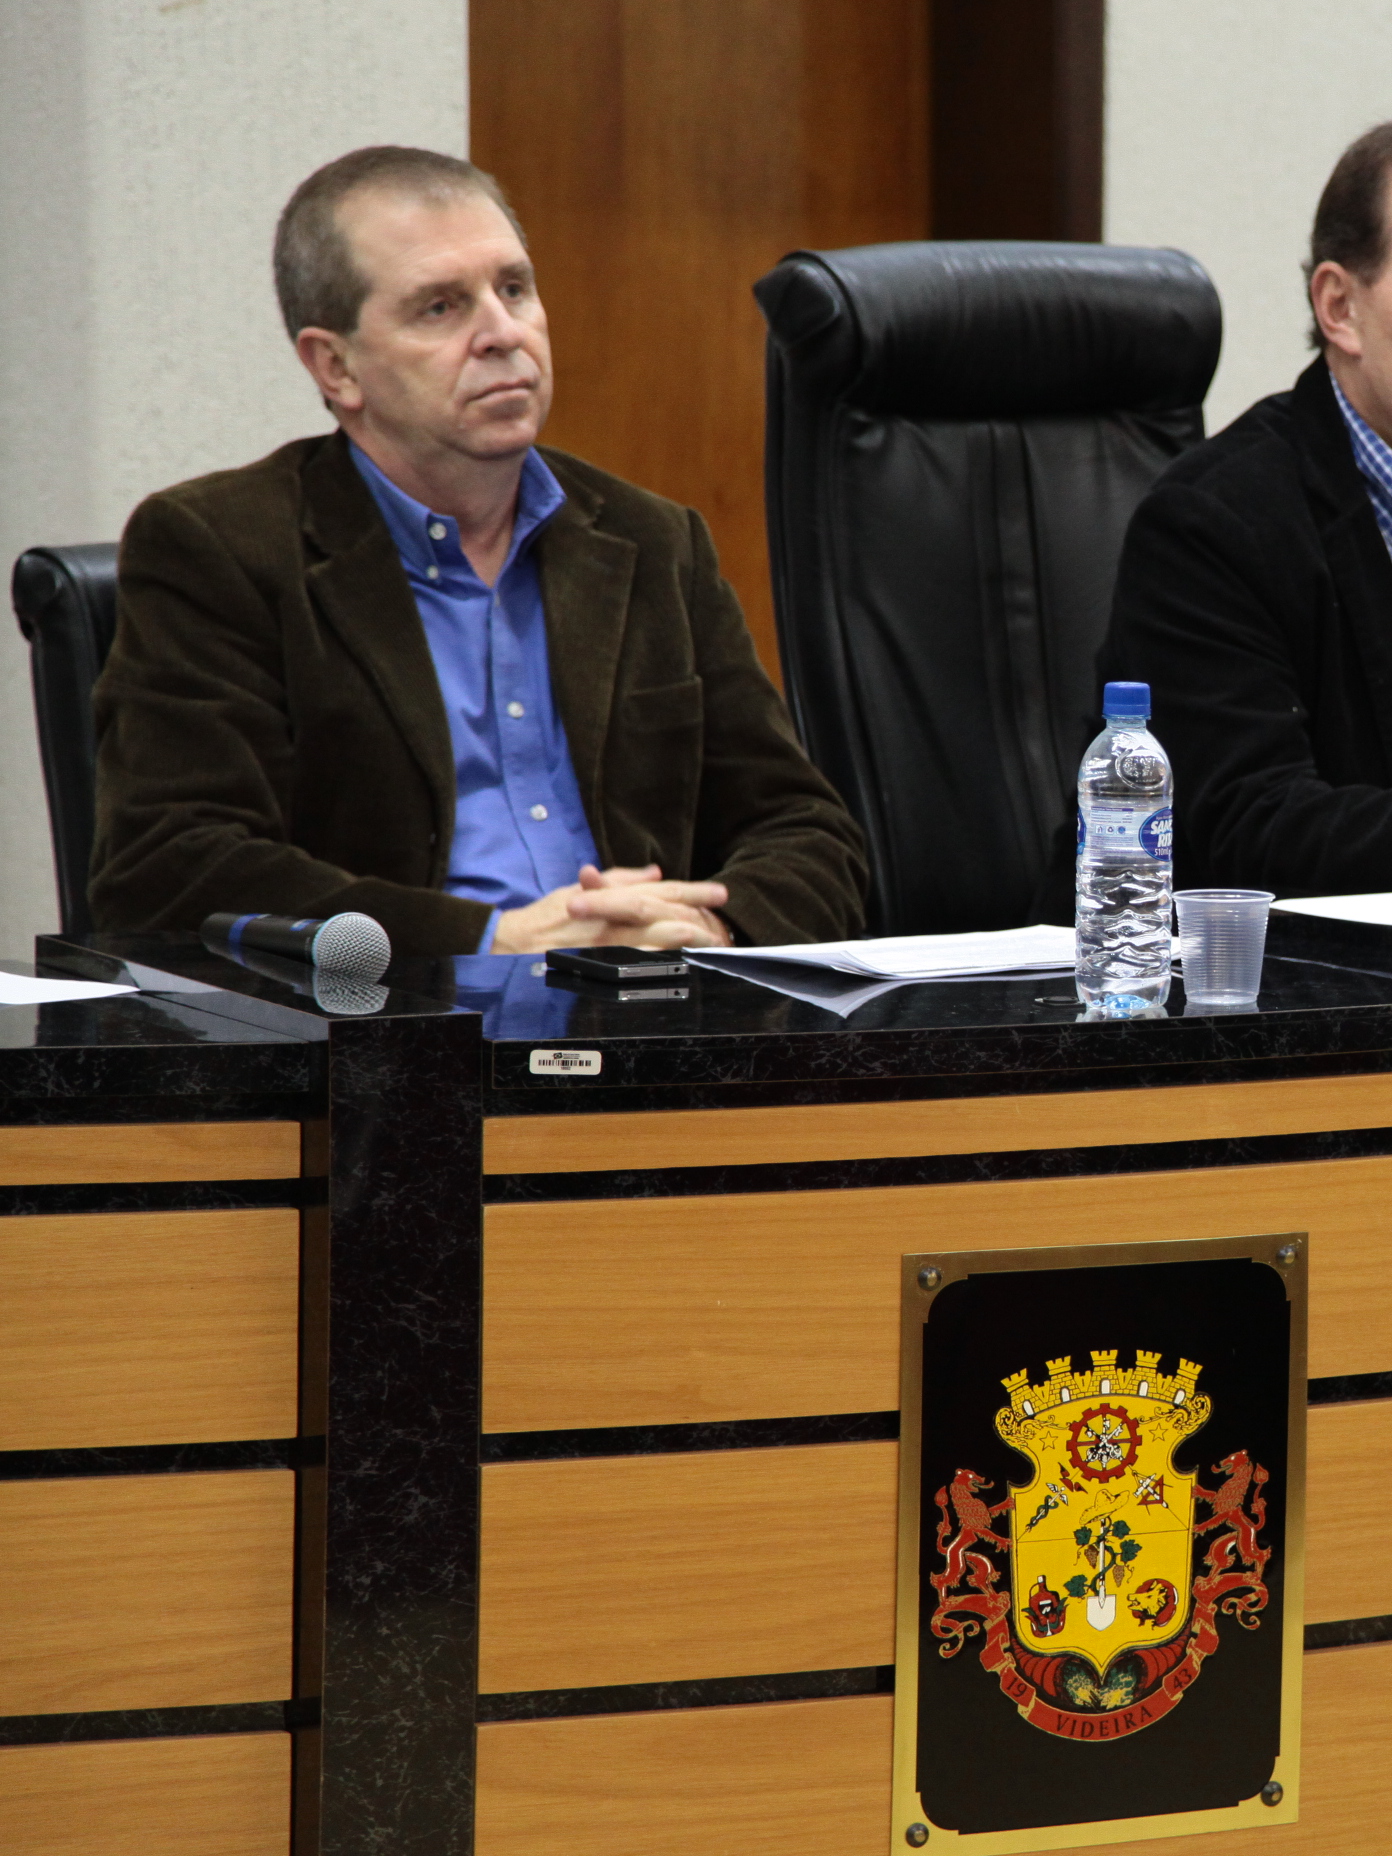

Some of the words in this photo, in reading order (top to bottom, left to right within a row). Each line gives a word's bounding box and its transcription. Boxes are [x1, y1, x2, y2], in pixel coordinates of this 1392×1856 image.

[1006, 1677, 1027, 1699] 19
[1055, 1704, 1154, 1739] VIDEIRA
[1172, 1668, 1194, 1692] 43
